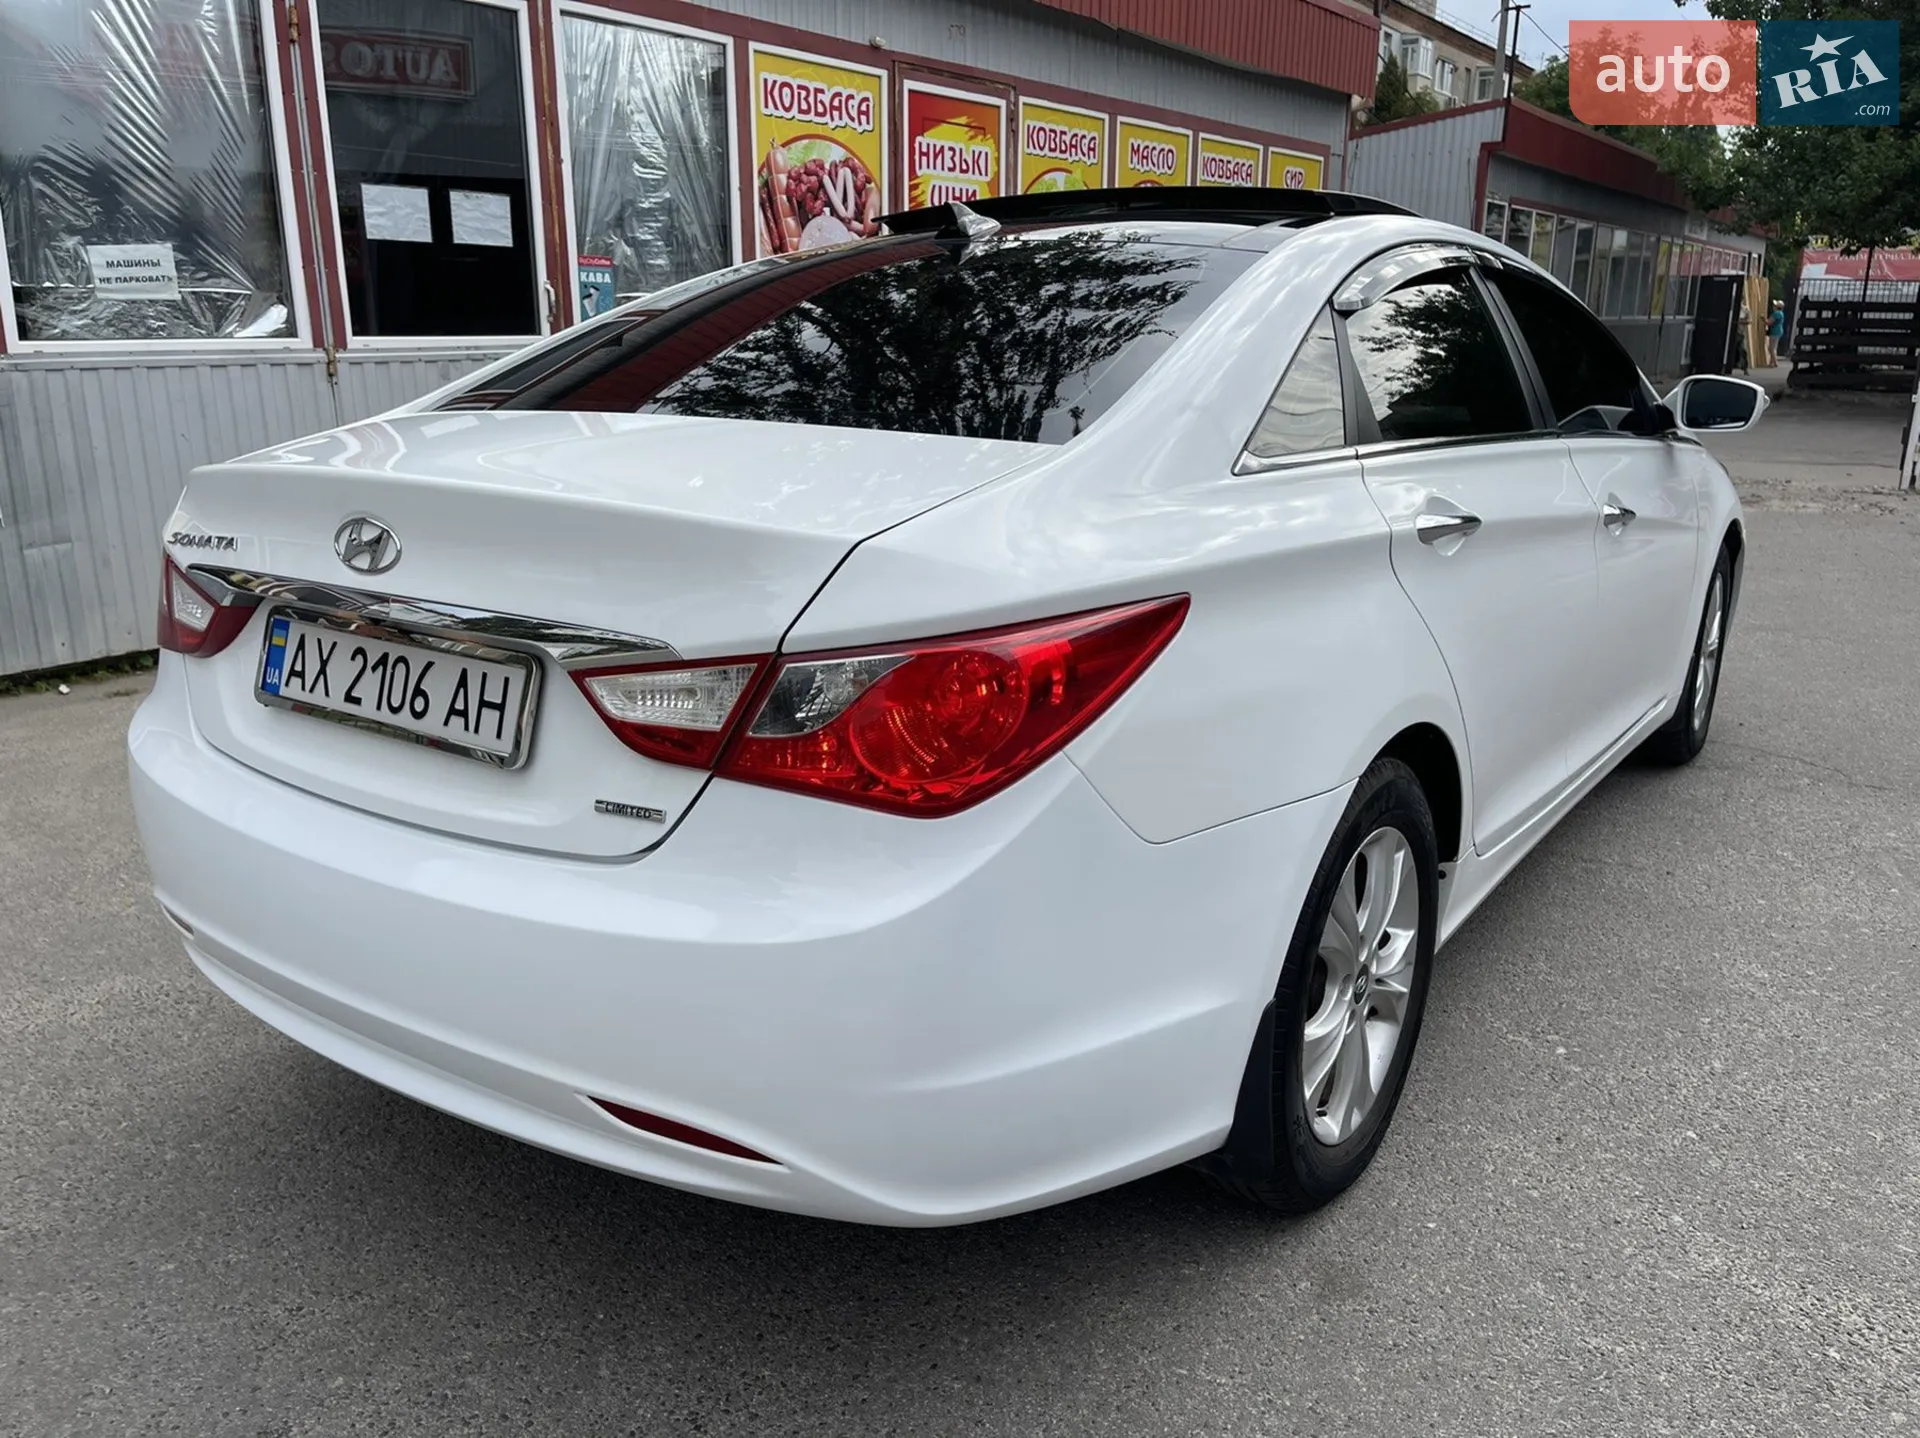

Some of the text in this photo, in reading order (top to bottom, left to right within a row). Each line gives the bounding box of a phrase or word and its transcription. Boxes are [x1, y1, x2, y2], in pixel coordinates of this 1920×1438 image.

[762, 77, 872, 127] КОВБАСА
[1026, 123, 1097, 161] КОВБАСА
[918, 141, 989, 177] НИЗЬКІ
[1129, 142, 1176, 171] МАСЛО
[1202, 156, 1253, 183] КОВБАСА
[1284, 168, 1303, 189] СИР
[105, 259, 162, 269] МАШИНЫ
[98, 276, 113, 285] НЕ
[580, 271, 612, 283] КАВА
[167, 531, 239, 552] SONATA
[265, 632, 510, 740] UA AX 2106 AH
[604, 801, 652, 819] LIMITED
